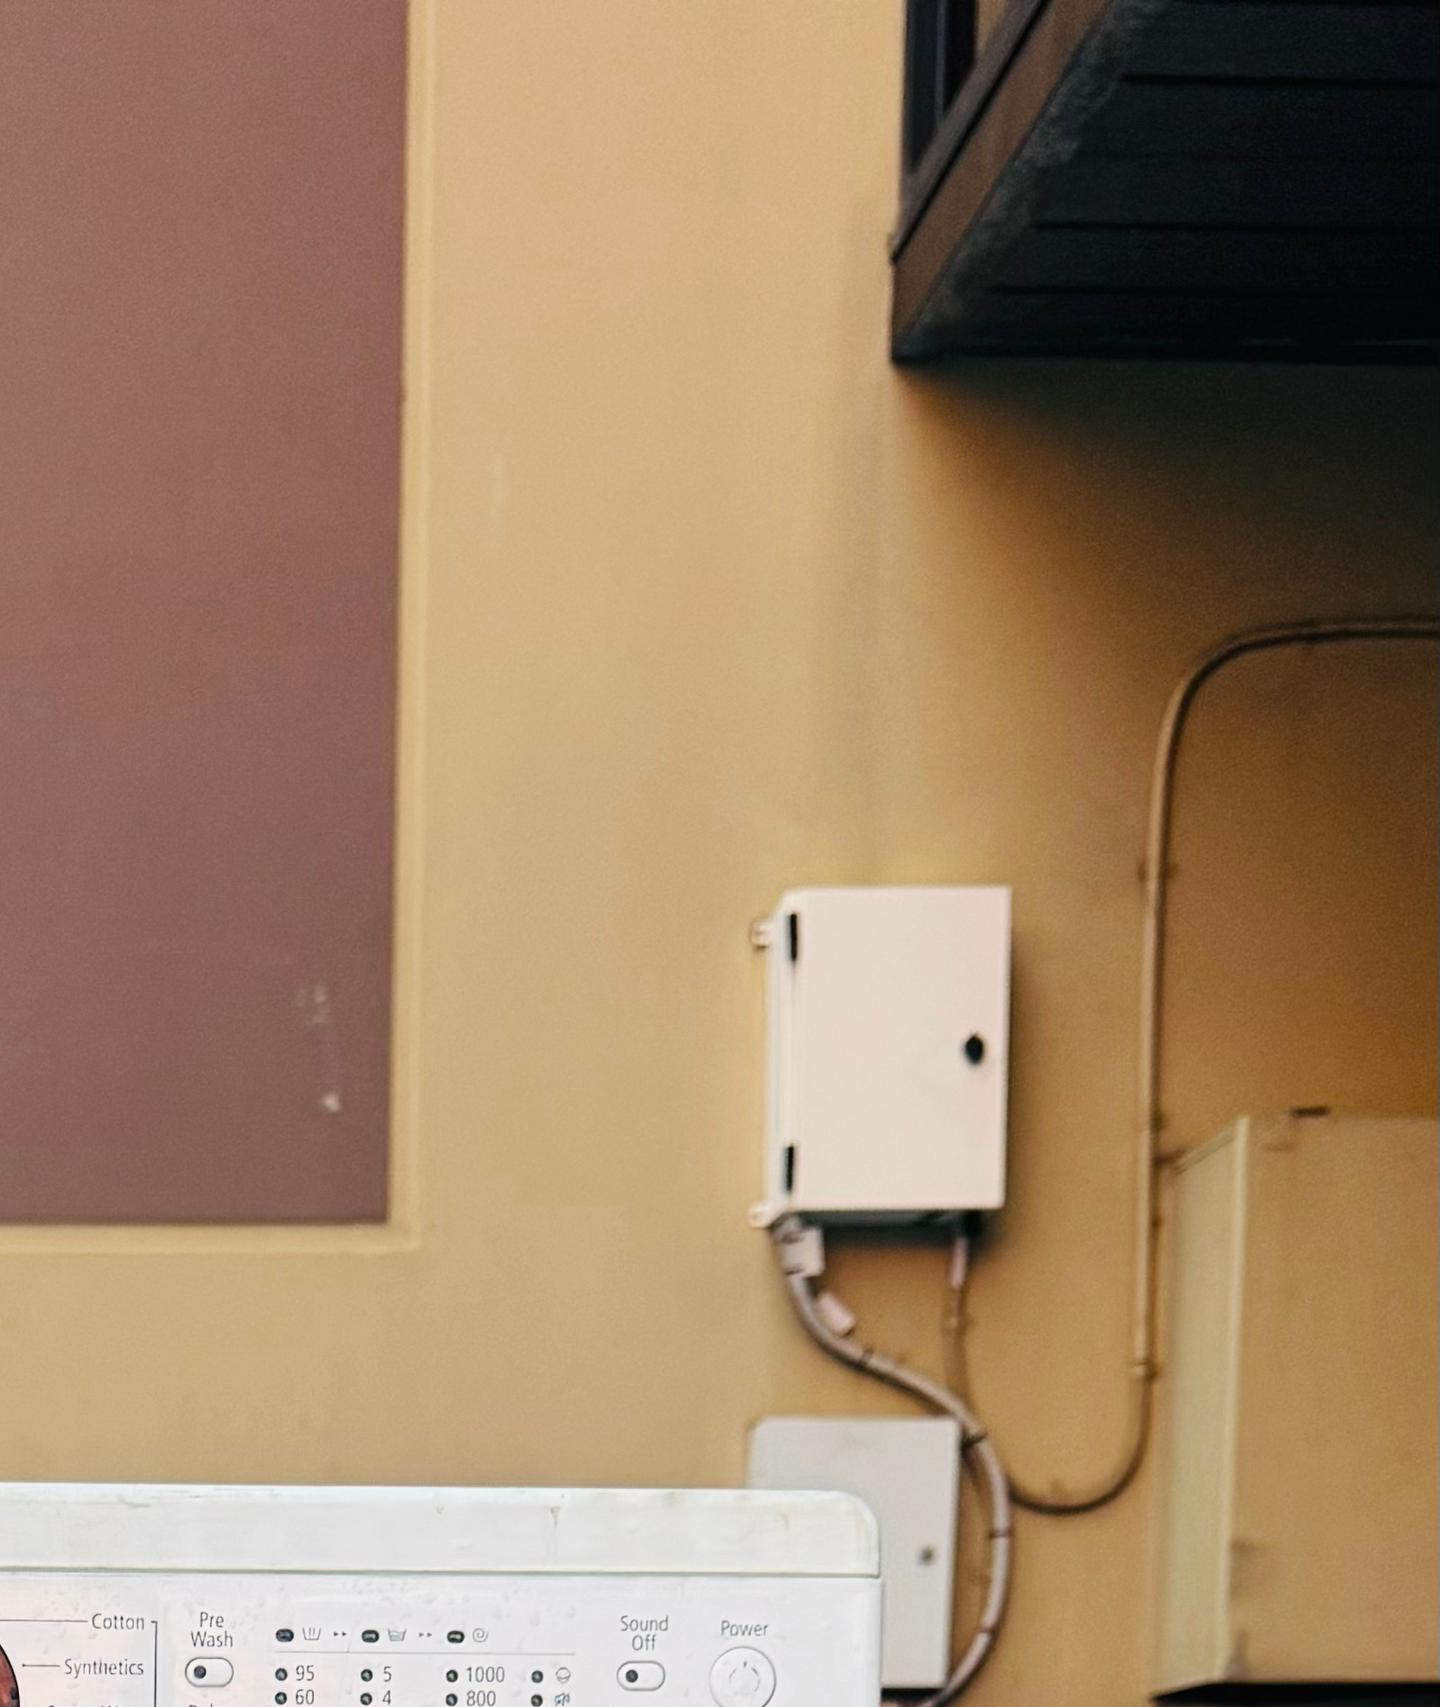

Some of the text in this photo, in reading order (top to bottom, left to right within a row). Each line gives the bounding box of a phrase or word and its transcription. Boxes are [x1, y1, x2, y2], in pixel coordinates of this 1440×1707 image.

[91, 1613, 145, 1631] Cotton
[199, 1612, 224, 1628] Pre
[620, 1615, 669, 1633] Sound
[720, 1621, 768, 1637] Power
[190, 1631, 234, 1648] Wash
[631, 1635, 657, 1652] Off
[64, 1658, 145, 1678] Synthetics
[294, 1666, 315, 1681] 95
[382, 1667, 392, 1682] 5
[465, 1667, 505, 1683] 1000
[294, 1690, 315, 1705] 60
[381, 1691, 392, 1705] 4
[465, 1691, 497, 1707] 800
